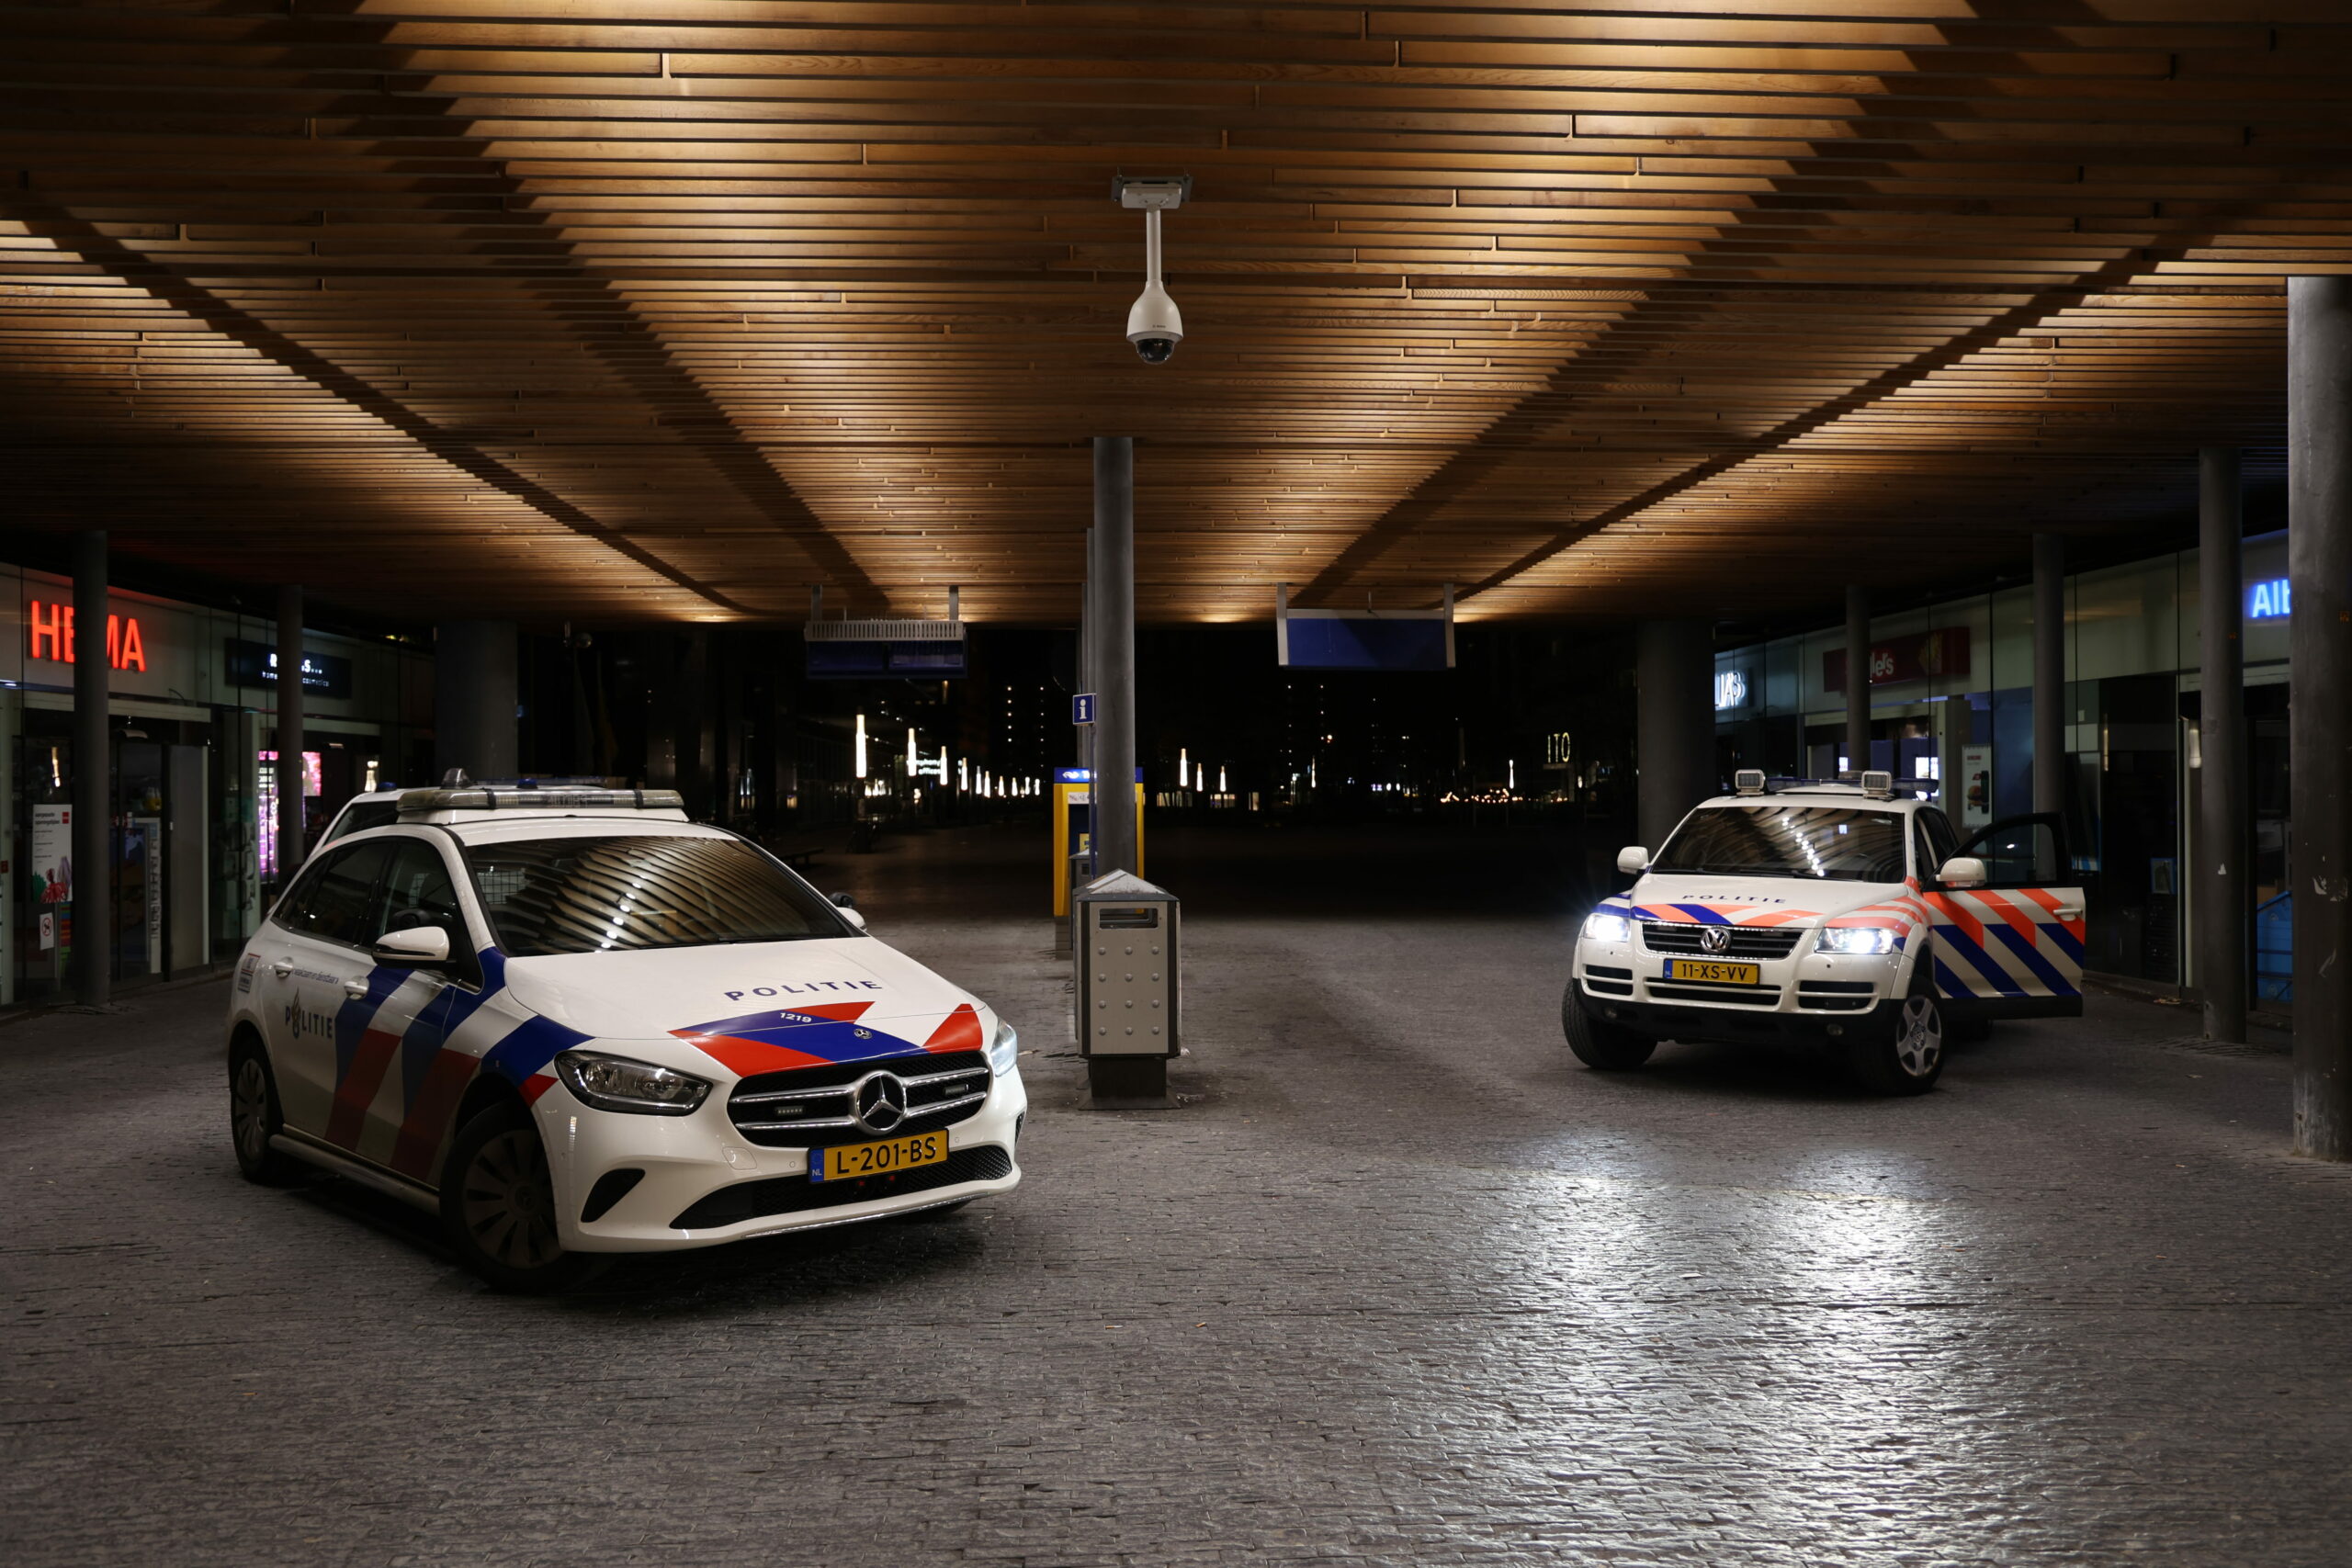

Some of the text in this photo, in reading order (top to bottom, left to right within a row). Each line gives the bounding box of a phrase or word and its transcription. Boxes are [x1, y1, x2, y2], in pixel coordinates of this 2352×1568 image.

[1682, 895, 1787, 904] POLITIE
[1682, 963, 1747, 980] 11-XS-VV
[724, 980, 883, 1001] POLITIE
[779, 1012, 812, 1023] 1219
[837, 1136, 936, 1175] L-201-BS
[811, 1168, 823, 1177] NL
